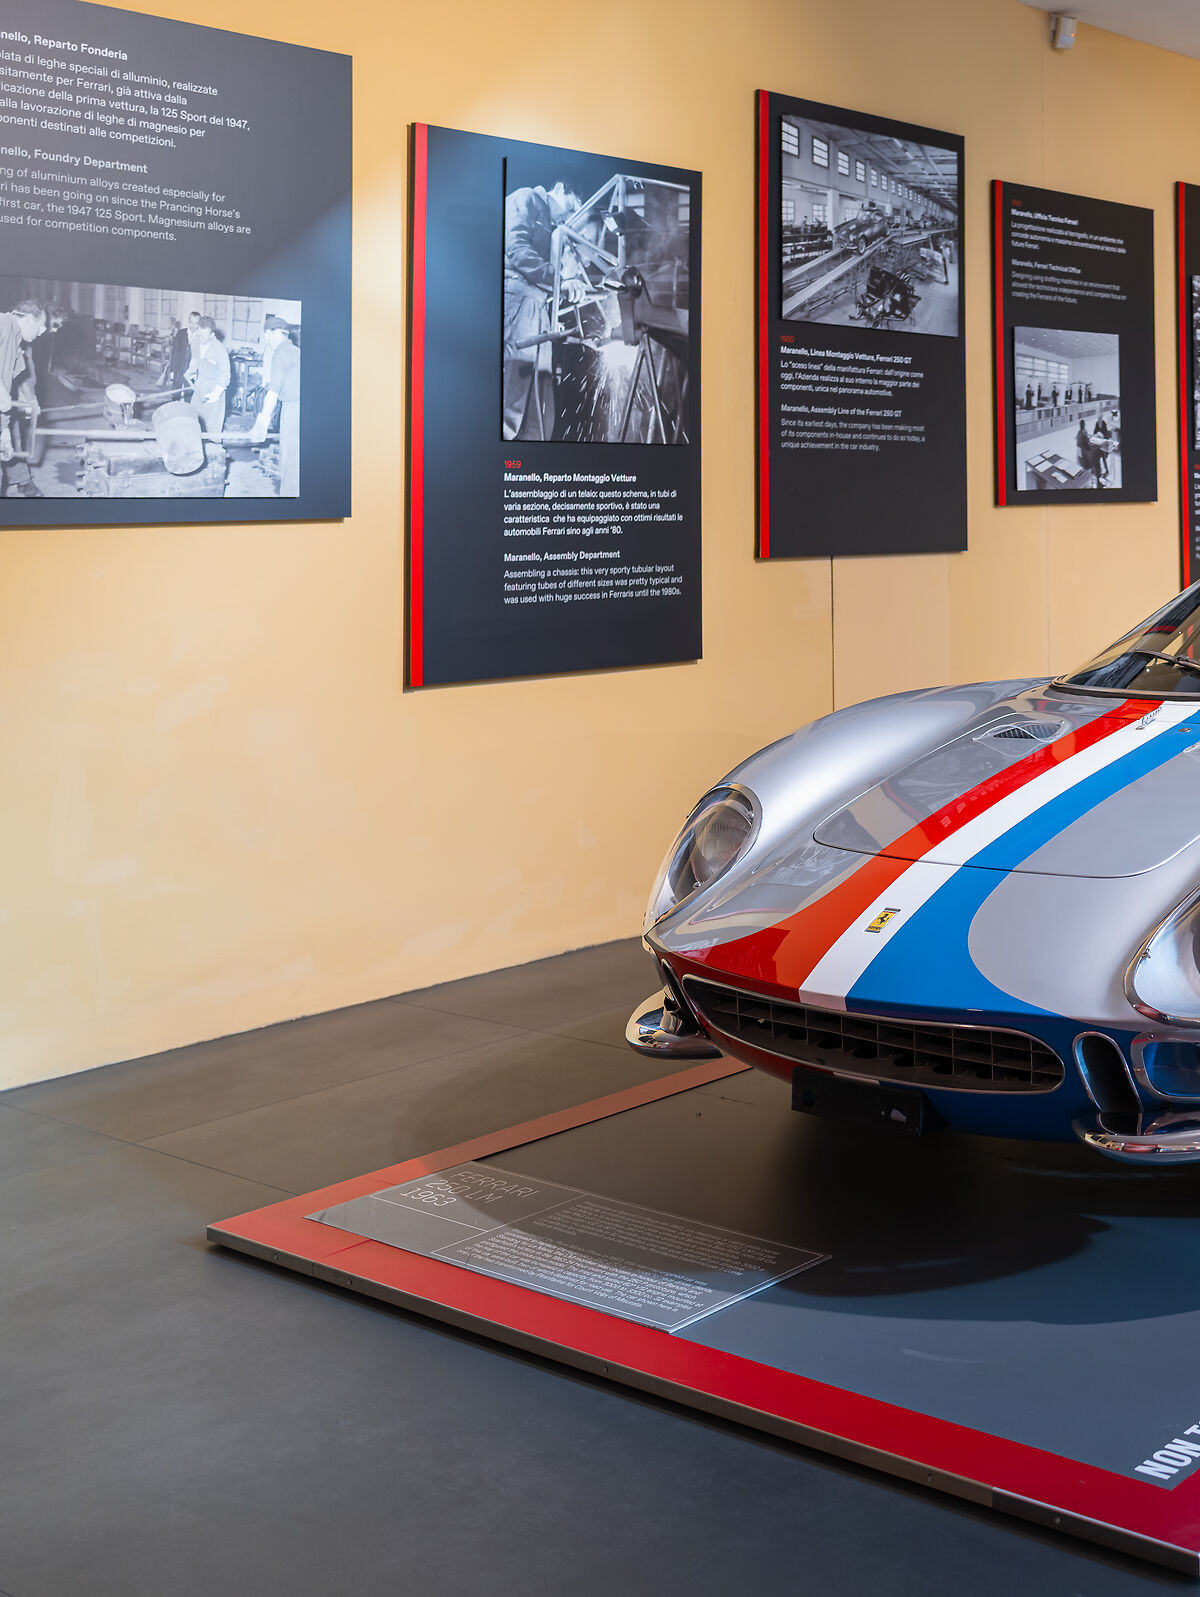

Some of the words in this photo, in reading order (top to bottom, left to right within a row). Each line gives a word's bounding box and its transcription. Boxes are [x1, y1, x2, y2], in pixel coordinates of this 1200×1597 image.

[34, 34, 78, 51] Reparto
[80, 43, 127, 61] Fonderia
[0, 49, 21, 62] lata
[24, 54, 34, 64] di
[37, 55, 66, 69] leghe
[69, 63, 108, 77] speciali
[110, 68, 120, 78] di
[122, 71, 170, 89] alluminio,
[172, 81, 217, 96] realizzate
[56, 76, 74, 86] per
[76, 77, 114, 94] Ferrari,
[116, 85, 131, 96] già
[133, 88, 162, 101] attiva
[163, 93, 187, 105] dalla
[47, 89, 74, 101] della
[75, 94, 106, 107] prima
[108, 100, 148, 115] vettura,
[149, 105, 159, 115] la
[160, 106, 178, 118] 125
[179, 110, 209, 123] Sport
[208, 115, 224, 126] del
[225, 117, 250, 131] 1947,
[34, 148, 80, 166] Foundry
[83, 155, 148, 173] Department
[16, 168, 28, 177] of
[30, 169, 87, 185] aluminium
[89, 177, 119, 190] alloys
[121, 182, 160, 194] created
[162, 187, 210, 202] especially
[211, 191, 226, 202] for
[10, 182, 30, 194] has
[33, 184, 60, 197] been
[62, 190, 93, 204] going
[95, 194, 108, 203] on
[111, 195, 138, 206] since
[140, 198, 157, 209] the
[159, 200, 203, 216] Prancing
[204, 205, 240, 219] Horse's
[23, 201, 43, 212] car,
[47, 202, 64, 213] the
[67, 204, 92, 216] 1947
[94, 207, 112, 219] 125
[114, 210, 145, 222] Sport.
[148, 213, 205, 229] Magnesium
[207, 221, 234, 233] alloys
[236, 225, 251, 234] are
[504, 460, 522, 469] 1959
[503, 472, 542, 483] Maranello,
[543, 472, 572, 483] Reparto
[572, 472, 610, 484] Montaggio
[610, 473, 636, 482] Vetture
[503, 489, 558, 500] L'assemblaggio
[559, 489, 566, 498] di
[567, 490, 577, 498] un
[577, 489, 598, 498] telaio:
[598, 490, 622, 499] questo
[622, 489, 649, 498] schema,
[650, 489, 656, 497] in
[657, 489, 670, 498] tubi
[670, 489, 677, 498] di
[503, 552, 542, 562] Maranello,
[542, 551, 578, 561] Assembly
[579, 550, 620, 560] Department
[503, 569, 546, 579] Assembling
[546, 569, 551, 577] a
[552, 567, 579, 577] chassis:
[580, 566, 594, 575] this
[594, 567, 609, 576] very
[609, 565, 631, 575] sporty
[631, 564, 654, 573] tubular
[654, 564, 674, 574] layout
[503, 596, 518, 604] was
[520, 594, 537, 603] used
[538, 593, 554, 602] with
[555, 592, 572, 603] huge
[574, 592, 600, 600] success
[601, 590, 608, 599] in
[609, 589, 633, 598] Ferraris
[634, 588, 648, 597] until
[650, 588, 660, 596] the
[661, 586, 681, 596] 1980s.
[426, 1179, 471, 1194] 250
[465, 1190, 504, 1204] LM
[450, 1171, 540, 1198] FERRARI
[400, 1188, 457, 1207] 1963
